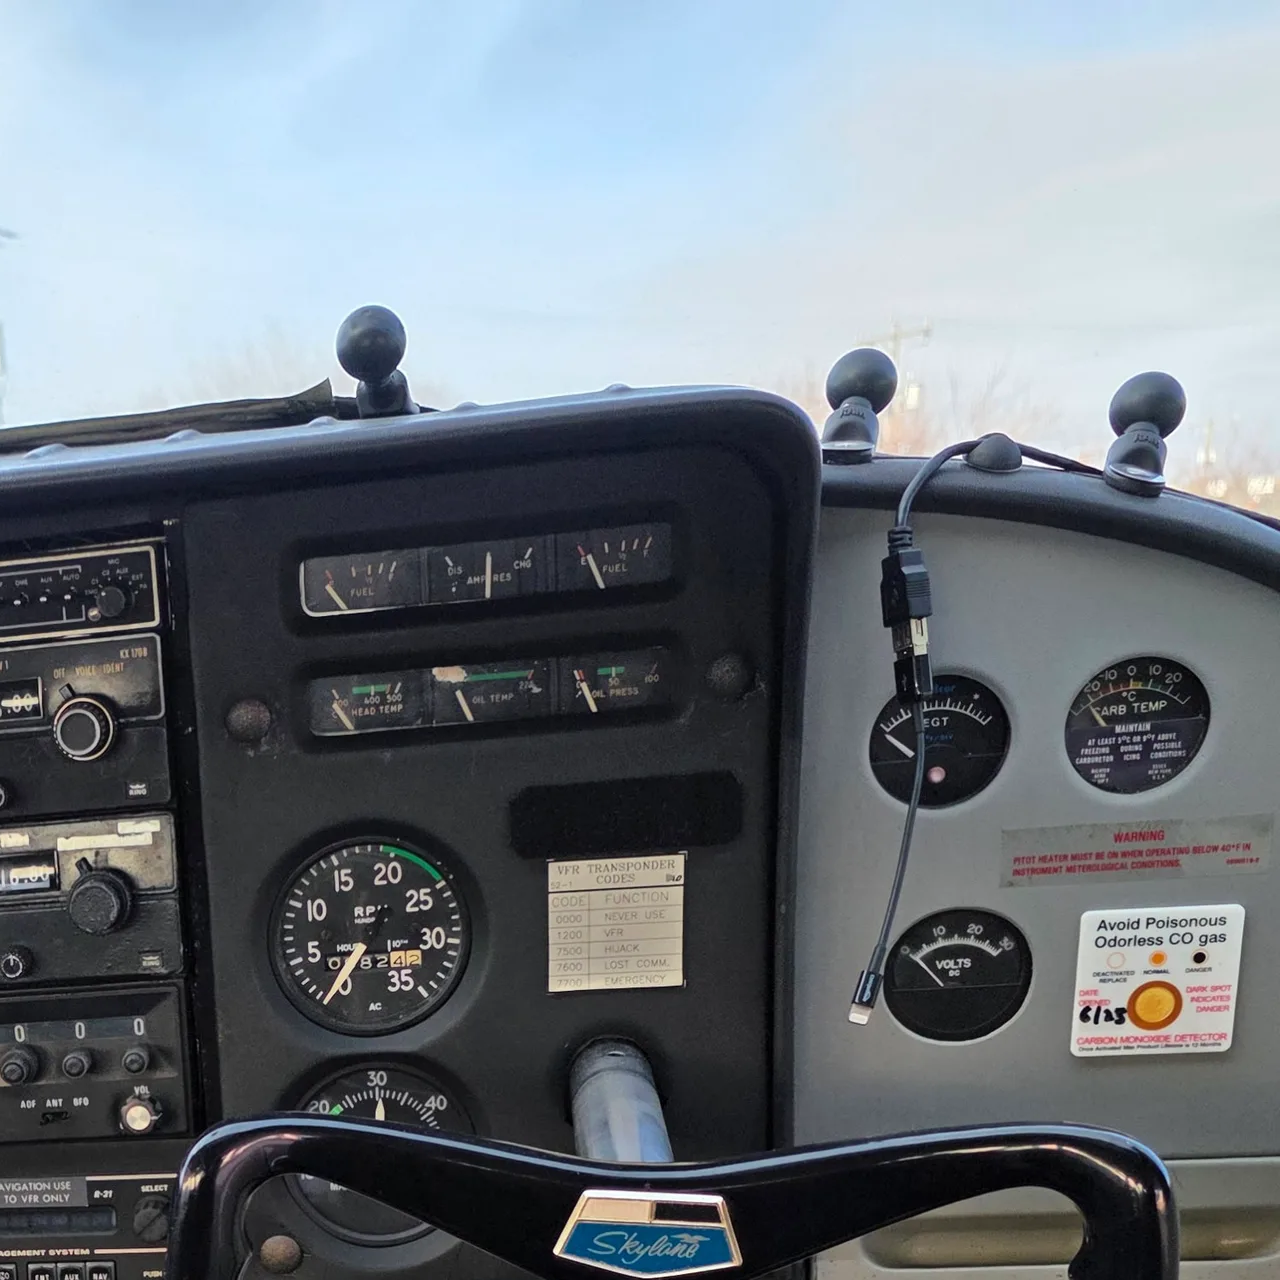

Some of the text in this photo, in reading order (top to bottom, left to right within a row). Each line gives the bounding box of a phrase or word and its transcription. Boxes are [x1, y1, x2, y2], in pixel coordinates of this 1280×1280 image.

[447, 566, 463, 576] DIS
[513, 560, 532, 570] CHG
[602, 563, 628, 574] FUEL
[53, 663, 125, 678] OFF VOICE IDENT
[1127, 665, 1136, 676] 0
[1149, 664, 1162, 676] 10
[1165, 672, 1182, 684] 20
[472, 692, 514, 705] OIL TEMP
[591, 686, 639, 699] OIL PRESS
[351, 704, 403, 717] HEAD TEMP
[1133, 700, 1167, 713] TEMP
[923, 717, 949, 728] EGT
[1115, 722, 1151, 733] MAINTAIN
[1098, 732, 1176, 745] LEAST ABOVE
[1081, 742, 1182, 755] FREEZING DURING POSSIBLE
[1076, 756, 1114, 764] CARBURETOR
[1150, 750, 1186, 759] CONDITIONS
[1113, 830, 1165, 844] WARNING
[1013, 856, 1035, 865] PITOT
[1038, 854, 1068, 864] HEATER
[1070, 852, 1092, 861] MUST
[1095, 851, 1106, 860] BE
[1107, 850, 1119, 859] ON
[1121, 849, 1144, 859] WHEN
[1145, 846, 1190, 857] OPERATING
[1192, 844, 1219, 854] BELOW
[1242, 842, 1251, 851] IN
[373, 861, 402, 886] 20
[557, 860, 675, 875] VFR TRANSPONDER
[1012, 866, 1063, 877] INSTRUMENT
[1131, 859, 1182, 870] CONDITIONS.
[333, 869, 354, 892] 15
[596, 874, 636, 885] CODES
[406, 888, 433, 913] 25
[551, 891, 669, 908] CODE FUNCTION
[307, 898, 327, 922] 10
[555, 909, 665, 924] 0000 NEVER USE
[967, 923, 984, 935] 20
[1097, 916, 1227, 932] Avoid Poisonous
[419, 926, 446, 950] 30
[557, 928, 624, 940] 1200 VFR
[1095, 932, 1227, 949] Odorless CO gas
[307, 941, 321, 963] 5
[556, 944, 640, 956] 7500 HIJACK
[556, 959, 670, 972] 7600 LOST COMM.
[936, 958, 972, 969] VOLTS
[387, 969, 415, 992] 35
[556, 974, 666, 988] 7700 EMERGENCY
[1078, 999, 1111, 1007] OPENED
[1190, 995, 1231, 1003] INDICATES
[369, 1002, 382, 1011] AC
[1196, 1005, 1230, 1013] DANGER
[1079, 1005, 1127, 1025] 6/25
[1077, 1033, 1228, 1045] CARBON MONOXIDE DETECTOR
[366, 1071, 387, 1086] 30
[134, 1086, 150, 1095] VOL
[46, 1099, 63, 1108] ANT
[424, 1095, 448, 1110] 40
[54, 1180, 71, 1190] USE
[141, 1184, 168, 1193] SELECT
[4, 1194, 17, 1204] TO
[20, 1194, 40, 1204] VFR
[43, 1193, 70, 1203] ONLY
[49, 1247, 90, 1256] SYSTEM
[587, 1231, 700, 1264] Skylane
